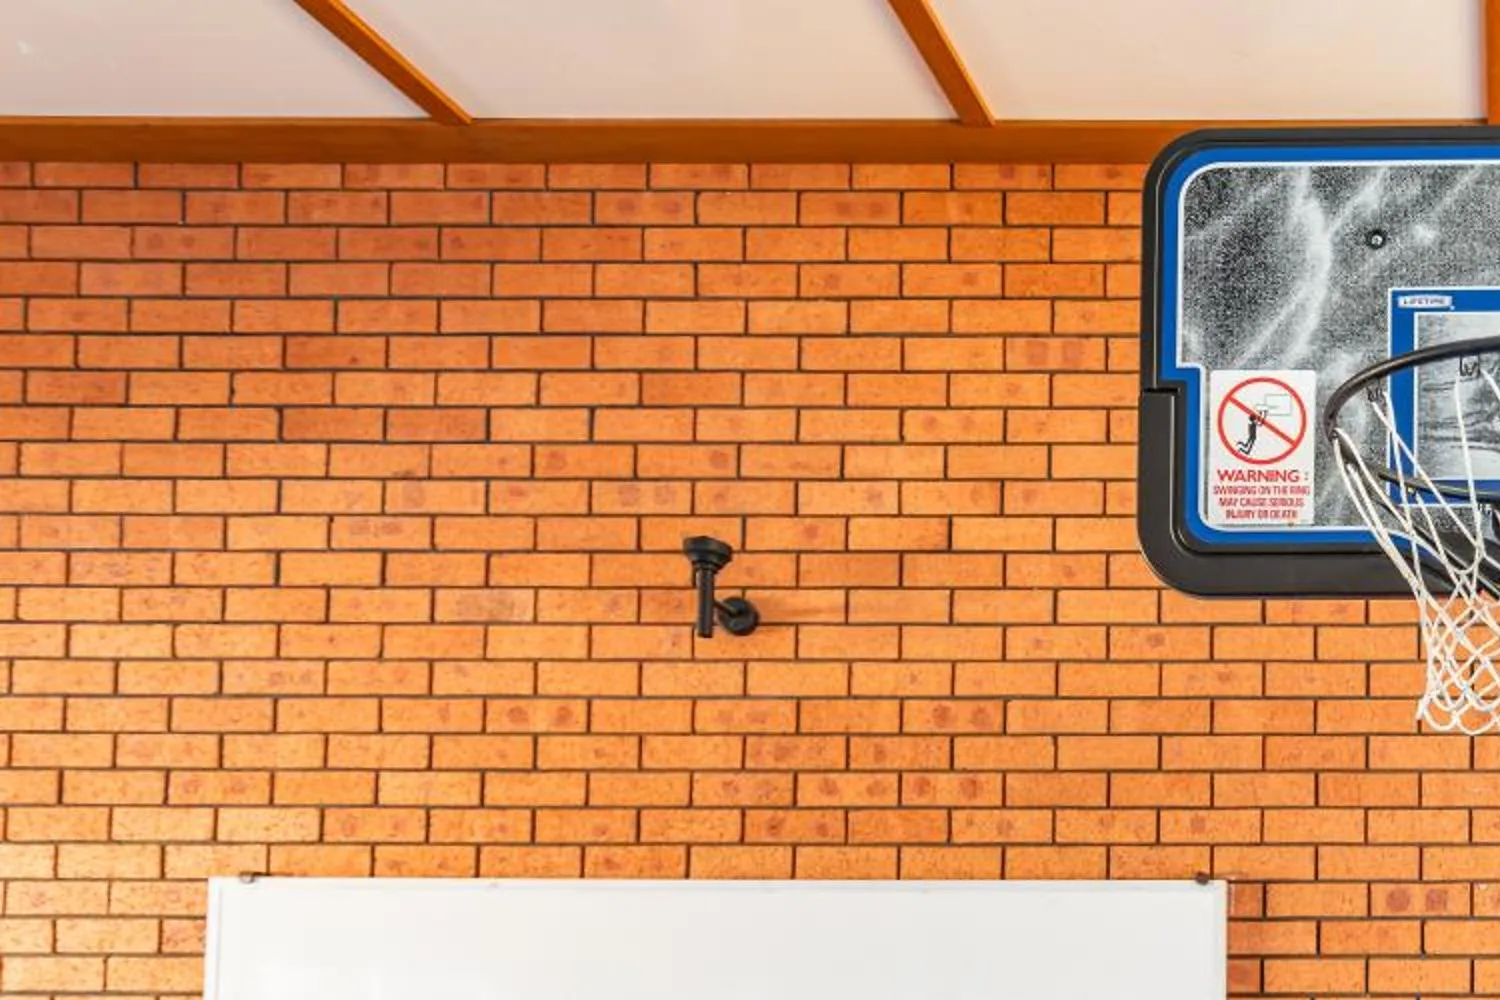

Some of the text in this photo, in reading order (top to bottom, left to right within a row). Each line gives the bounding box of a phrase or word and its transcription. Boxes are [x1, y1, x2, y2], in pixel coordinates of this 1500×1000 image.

[1213, 485, 1310, 495] SWINGING ON THE RING
[1219, 498, 1305, 507] MAY CAUSE SERIOUS
[1226, 509, 1298, 519] INJURY OR DEATH
